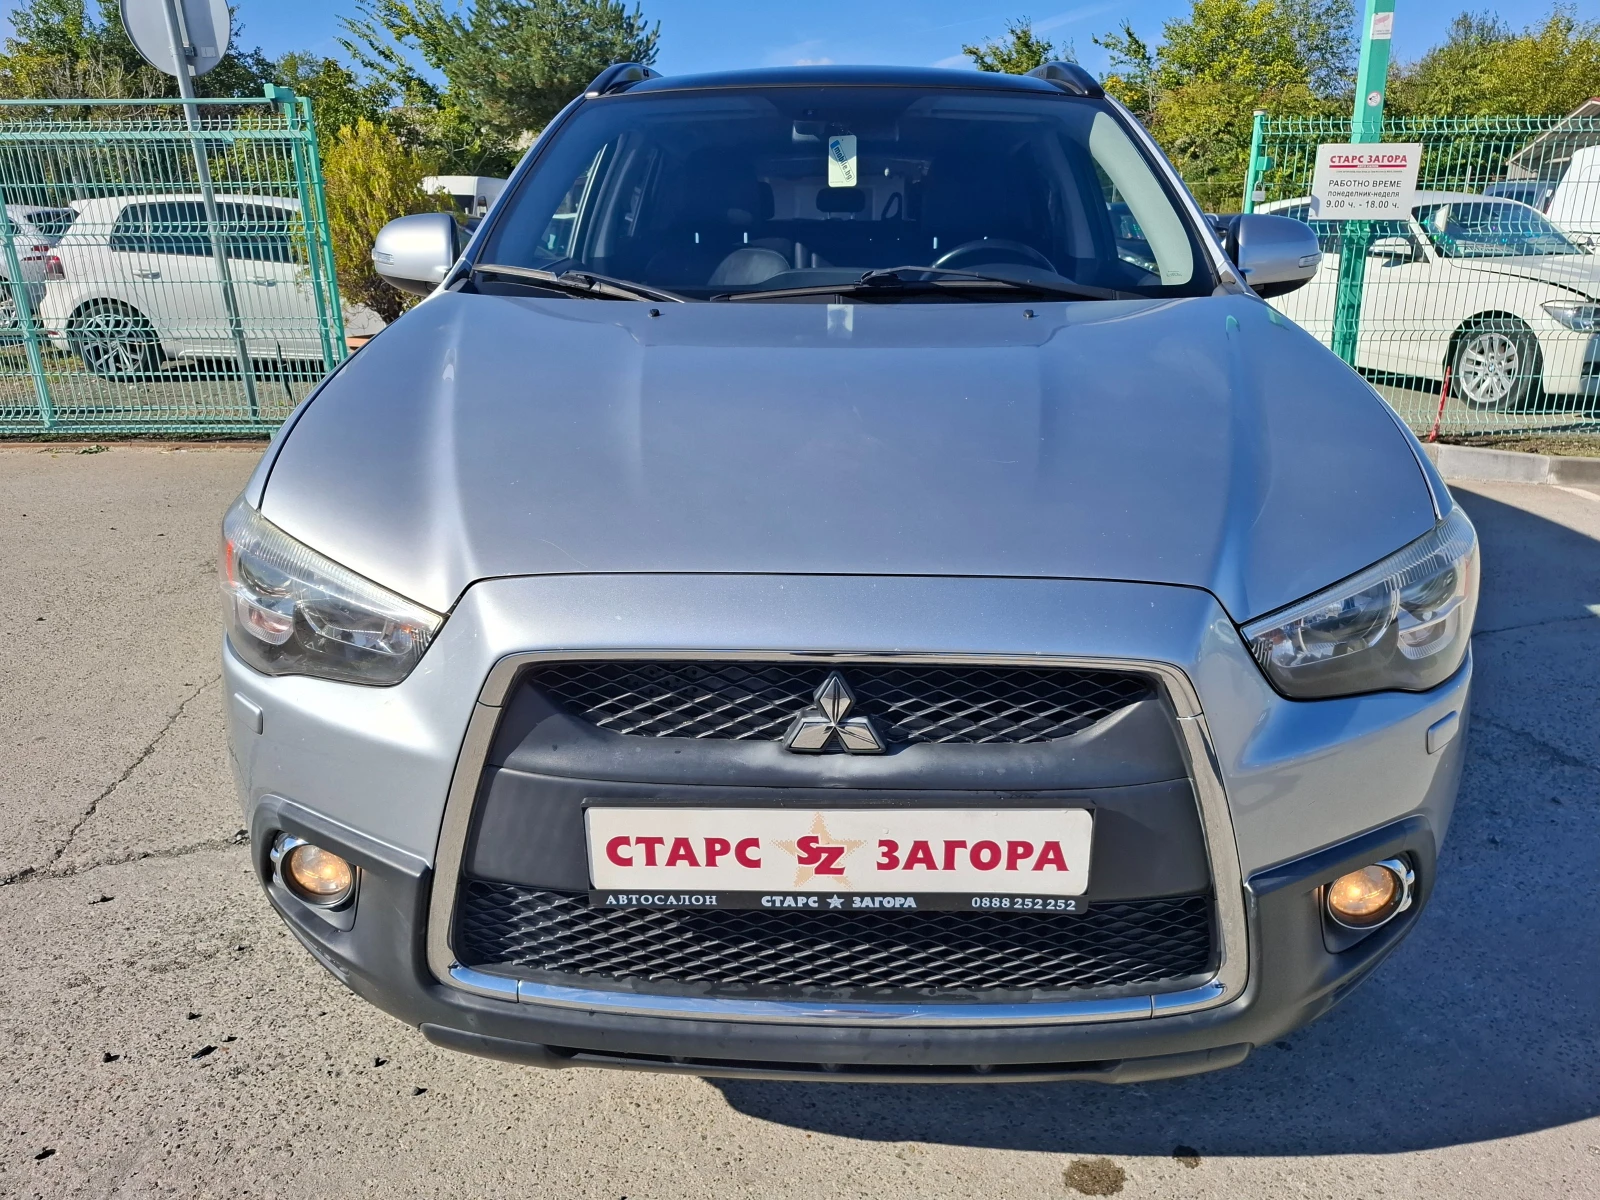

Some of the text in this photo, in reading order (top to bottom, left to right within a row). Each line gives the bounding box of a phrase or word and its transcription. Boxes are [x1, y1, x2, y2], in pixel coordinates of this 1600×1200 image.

[834, 146, 853, 181] mobile.bg
[1330, 155, 1407, 164] СТАРС ЗАГОРА
[1328, 180, 1402, 188] РАБОТНО ВРЕМЕ
[1327, 190, 1400, 198] понеделник-неделя
[1326, 200, 1345, 208] 9.00
[1365, 200, 1389, 209] 18.00
[605, 835, 762, 869] СТАРС
[796, 835, 846, 876] SZ
[876, 839, 1070, 872] ЗАГОРА
[606, 894, 717, 906] АВТОСАЛОН
[761, 895, 917, 909] СТАРС ЗАГОРА
[971, 896, 1076, 911] 0888 252 252
